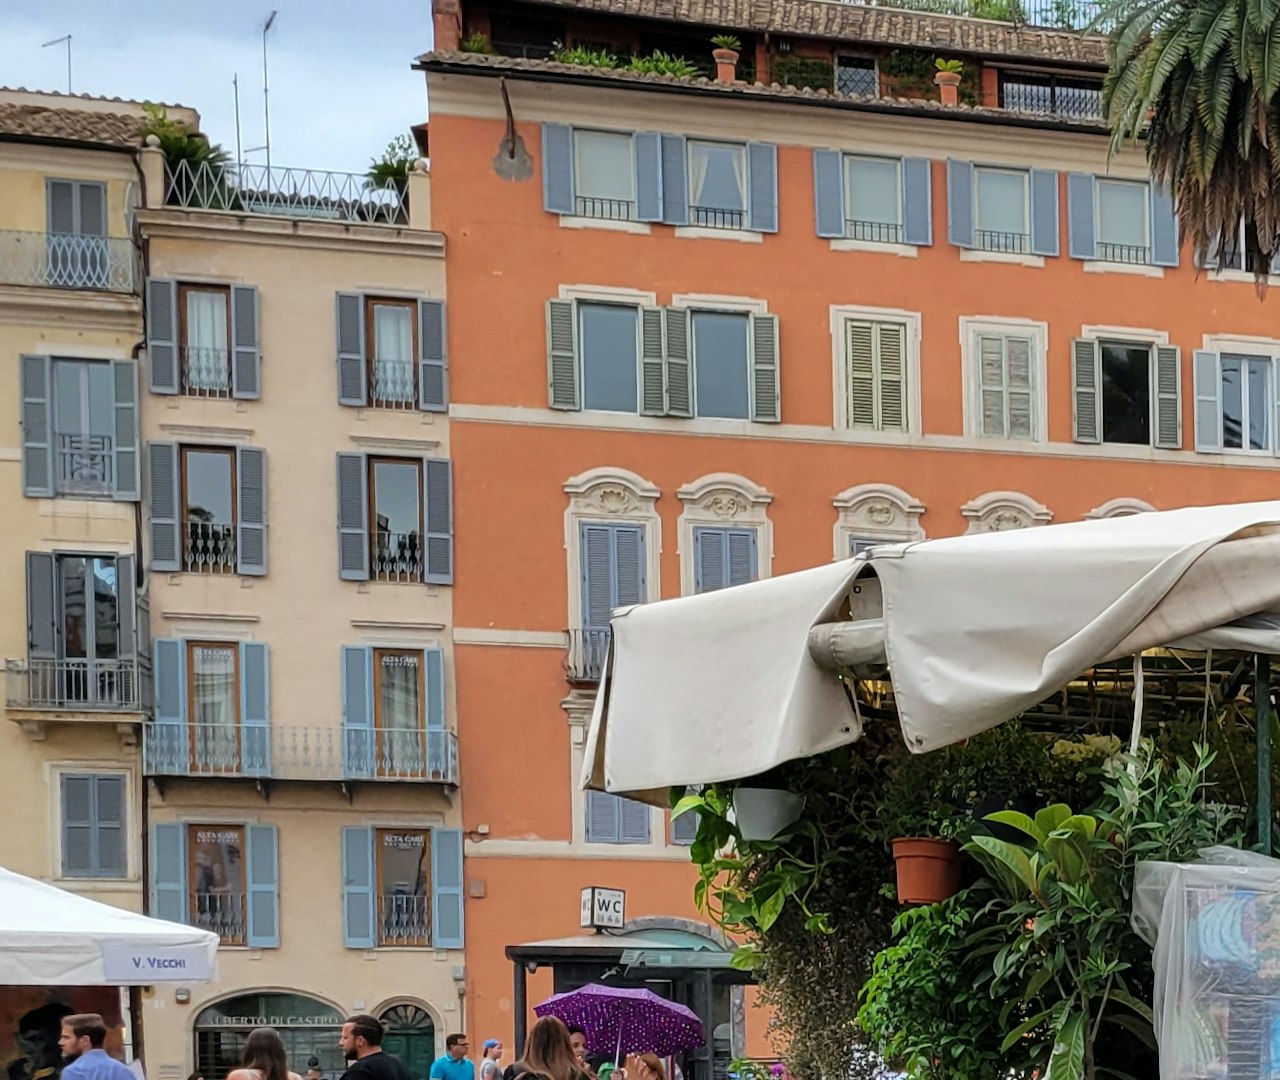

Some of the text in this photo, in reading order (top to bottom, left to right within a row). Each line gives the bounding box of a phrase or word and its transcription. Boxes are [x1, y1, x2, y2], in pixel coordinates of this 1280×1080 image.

[596, 898, 622, 913] WC
[132, 957, 186, 968] V. VECCHI
[208, 1015, 339, 1026] ALBERTO DI CASTRO
